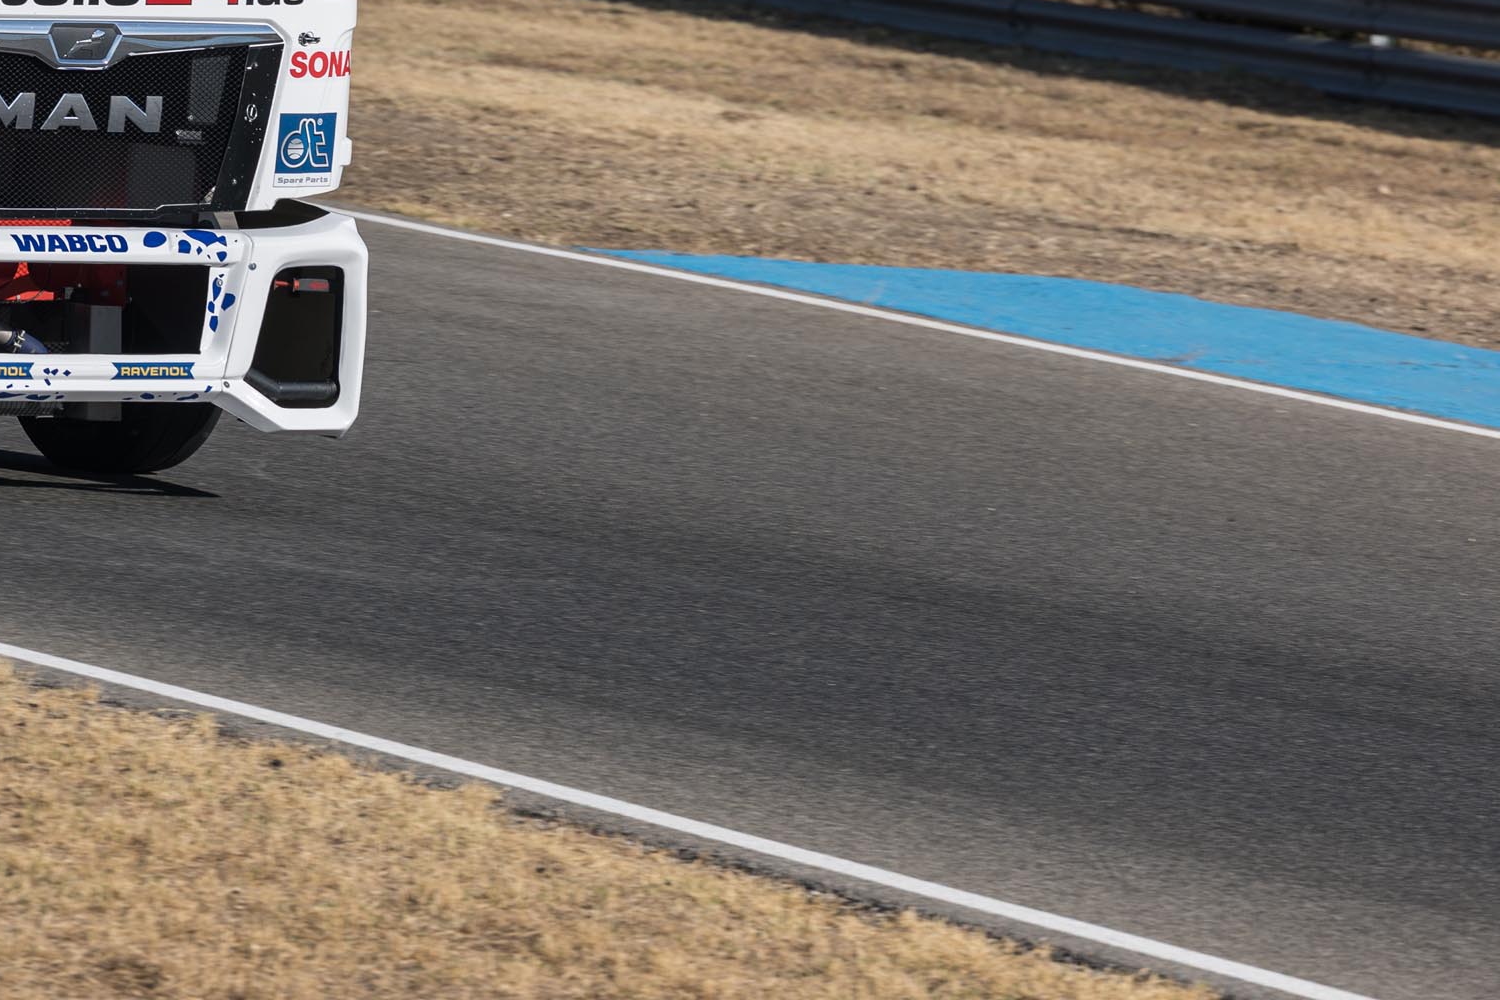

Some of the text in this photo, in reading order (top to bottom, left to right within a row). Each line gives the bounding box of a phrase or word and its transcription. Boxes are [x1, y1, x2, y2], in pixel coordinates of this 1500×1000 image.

[278, 176, 304, 185] Spare
[11, 234, 129, 253] WABCO
[120, 366, 186, 377] RAVENOL
